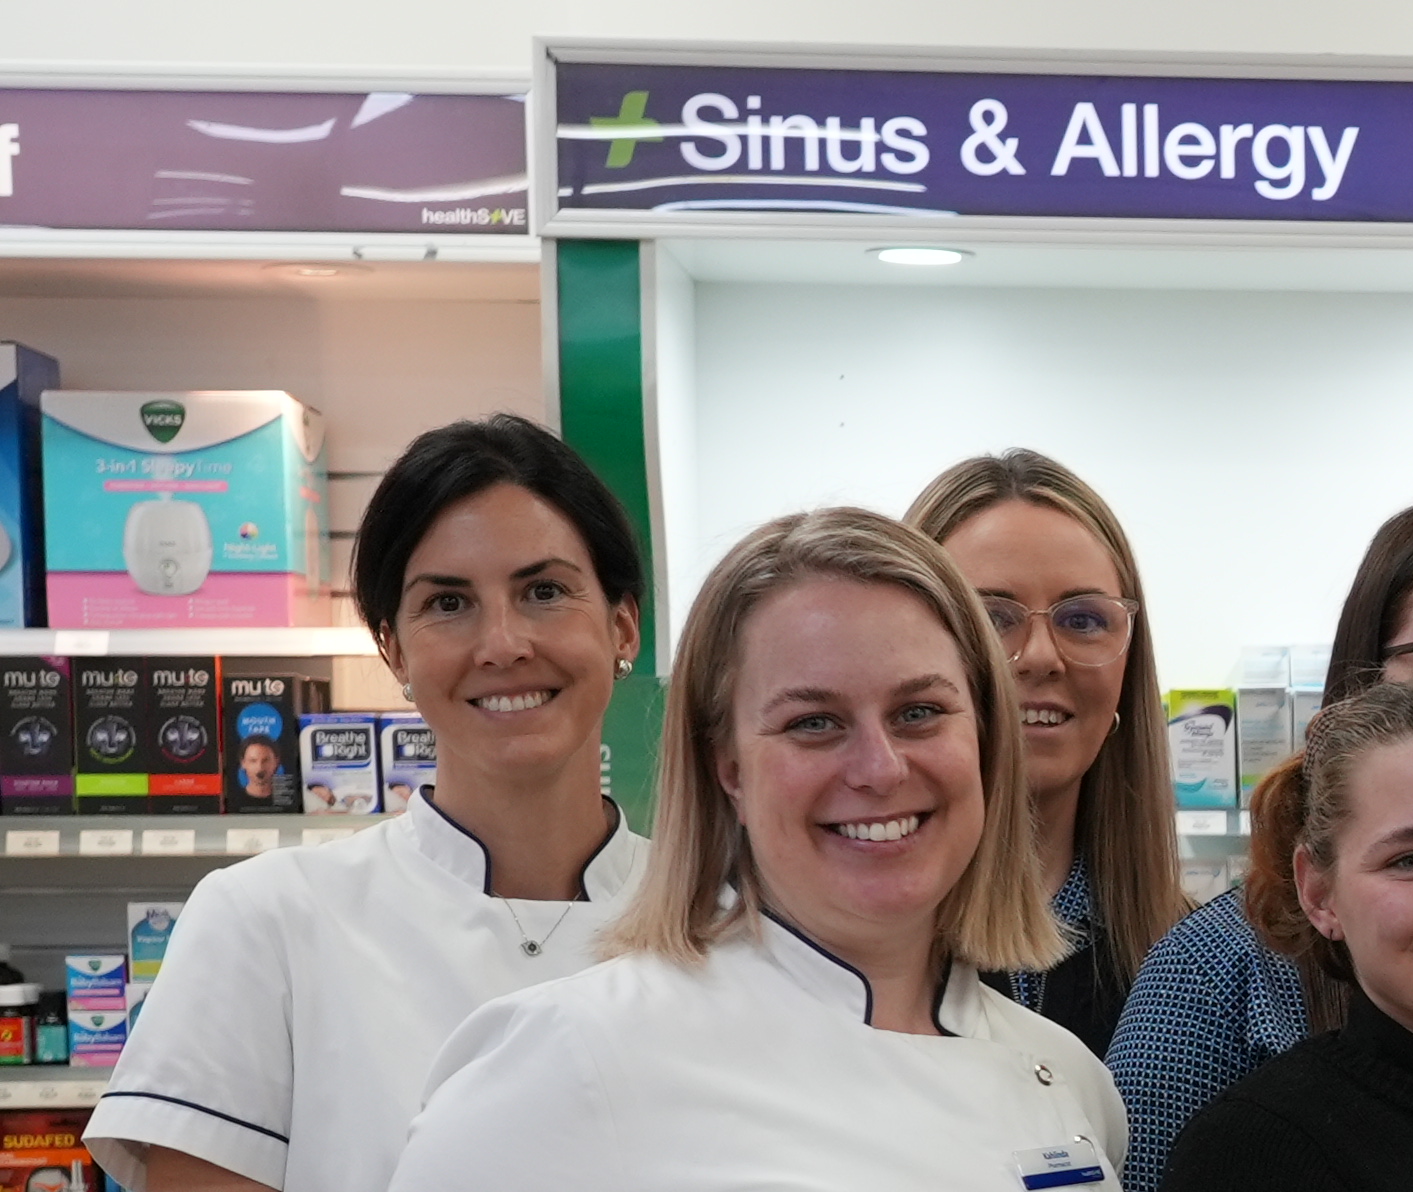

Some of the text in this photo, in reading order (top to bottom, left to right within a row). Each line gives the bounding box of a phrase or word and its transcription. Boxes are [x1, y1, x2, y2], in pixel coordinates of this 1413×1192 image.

[680, 92, 1360, 201] Sinus & Allergy
[144, 413, 182, 427] VICKS
[3, 669, 61, 688] mute
[82, 668, 139, 687] mute
[152, 668, 210, 687] mute
[231, 678, 285, 697] mute
[315, 731, 366, 745] Breathe
[333, 743, 366, 759] Right
[3, 1133, 75, 1149] SUDAFED
